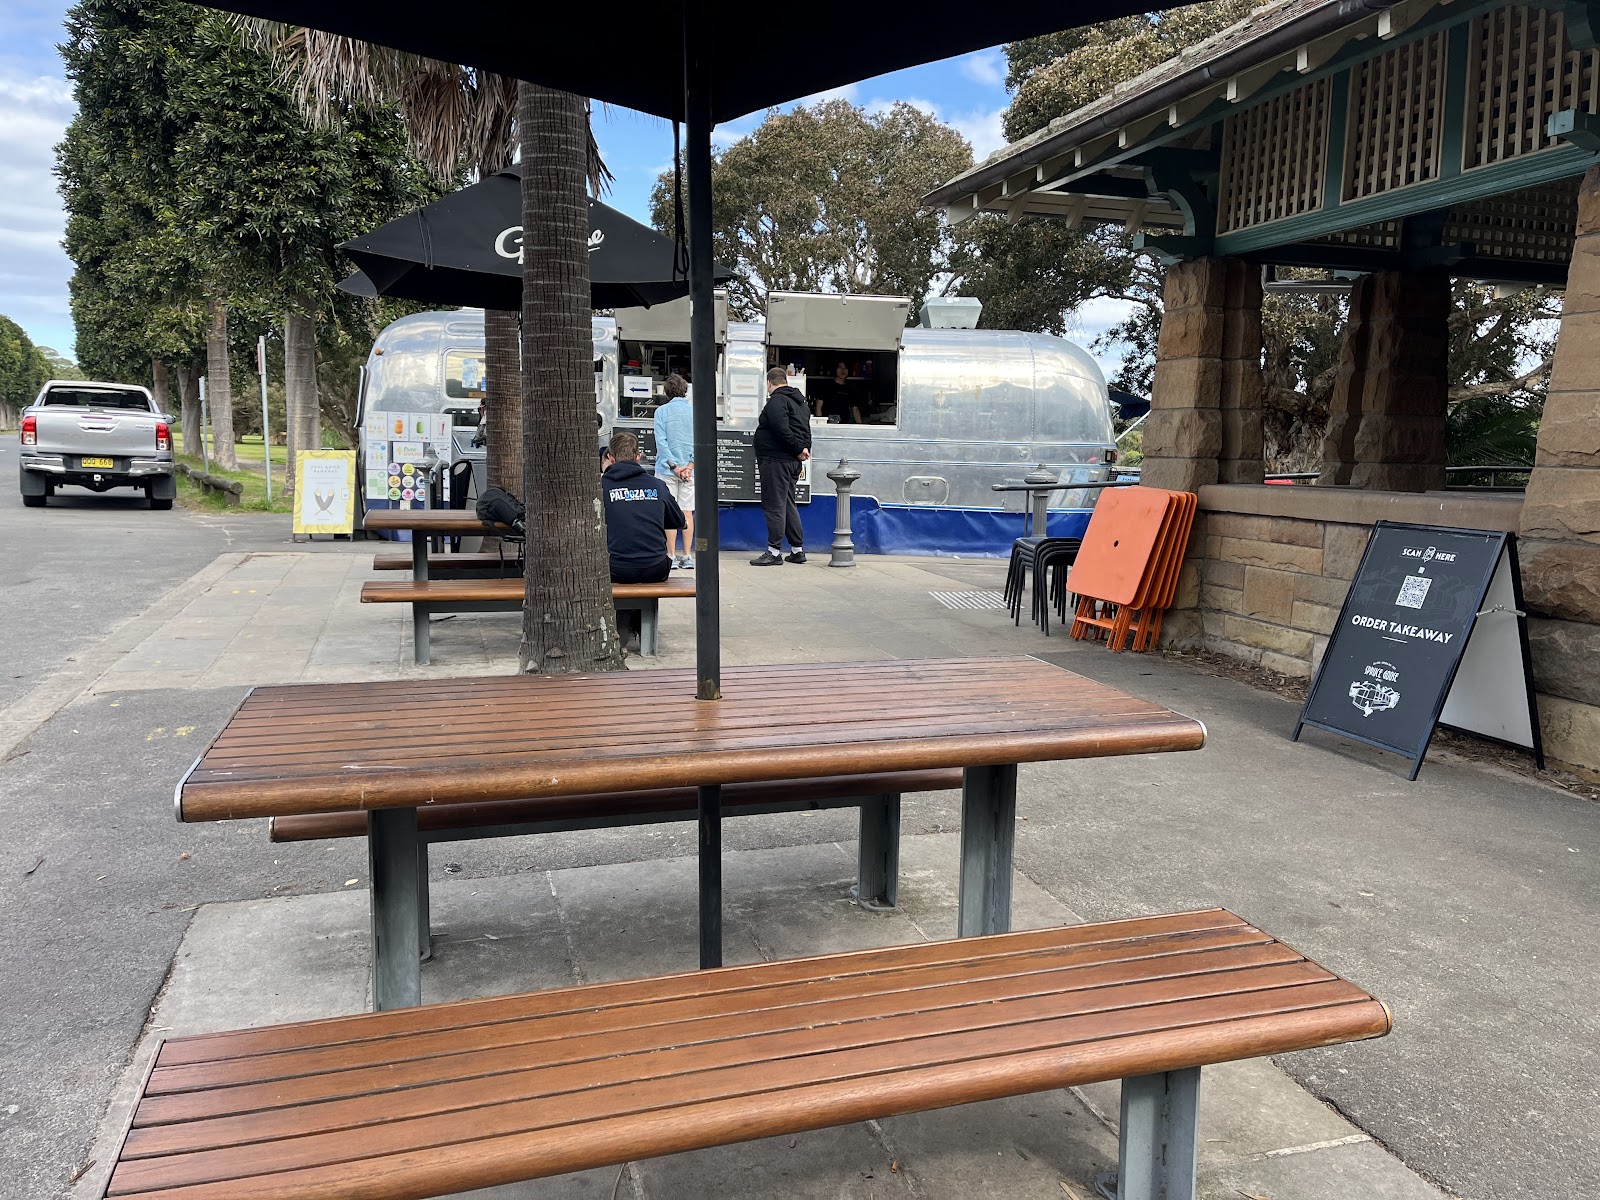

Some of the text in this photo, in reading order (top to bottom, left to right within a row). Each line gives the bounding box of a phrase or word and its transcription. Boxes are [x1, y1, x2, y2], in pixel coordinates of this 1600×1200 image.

[1402, 548, 1456, 562] SCAN HERE
[1351, 614, 1453, 644] ORDER TAKEAWAY
